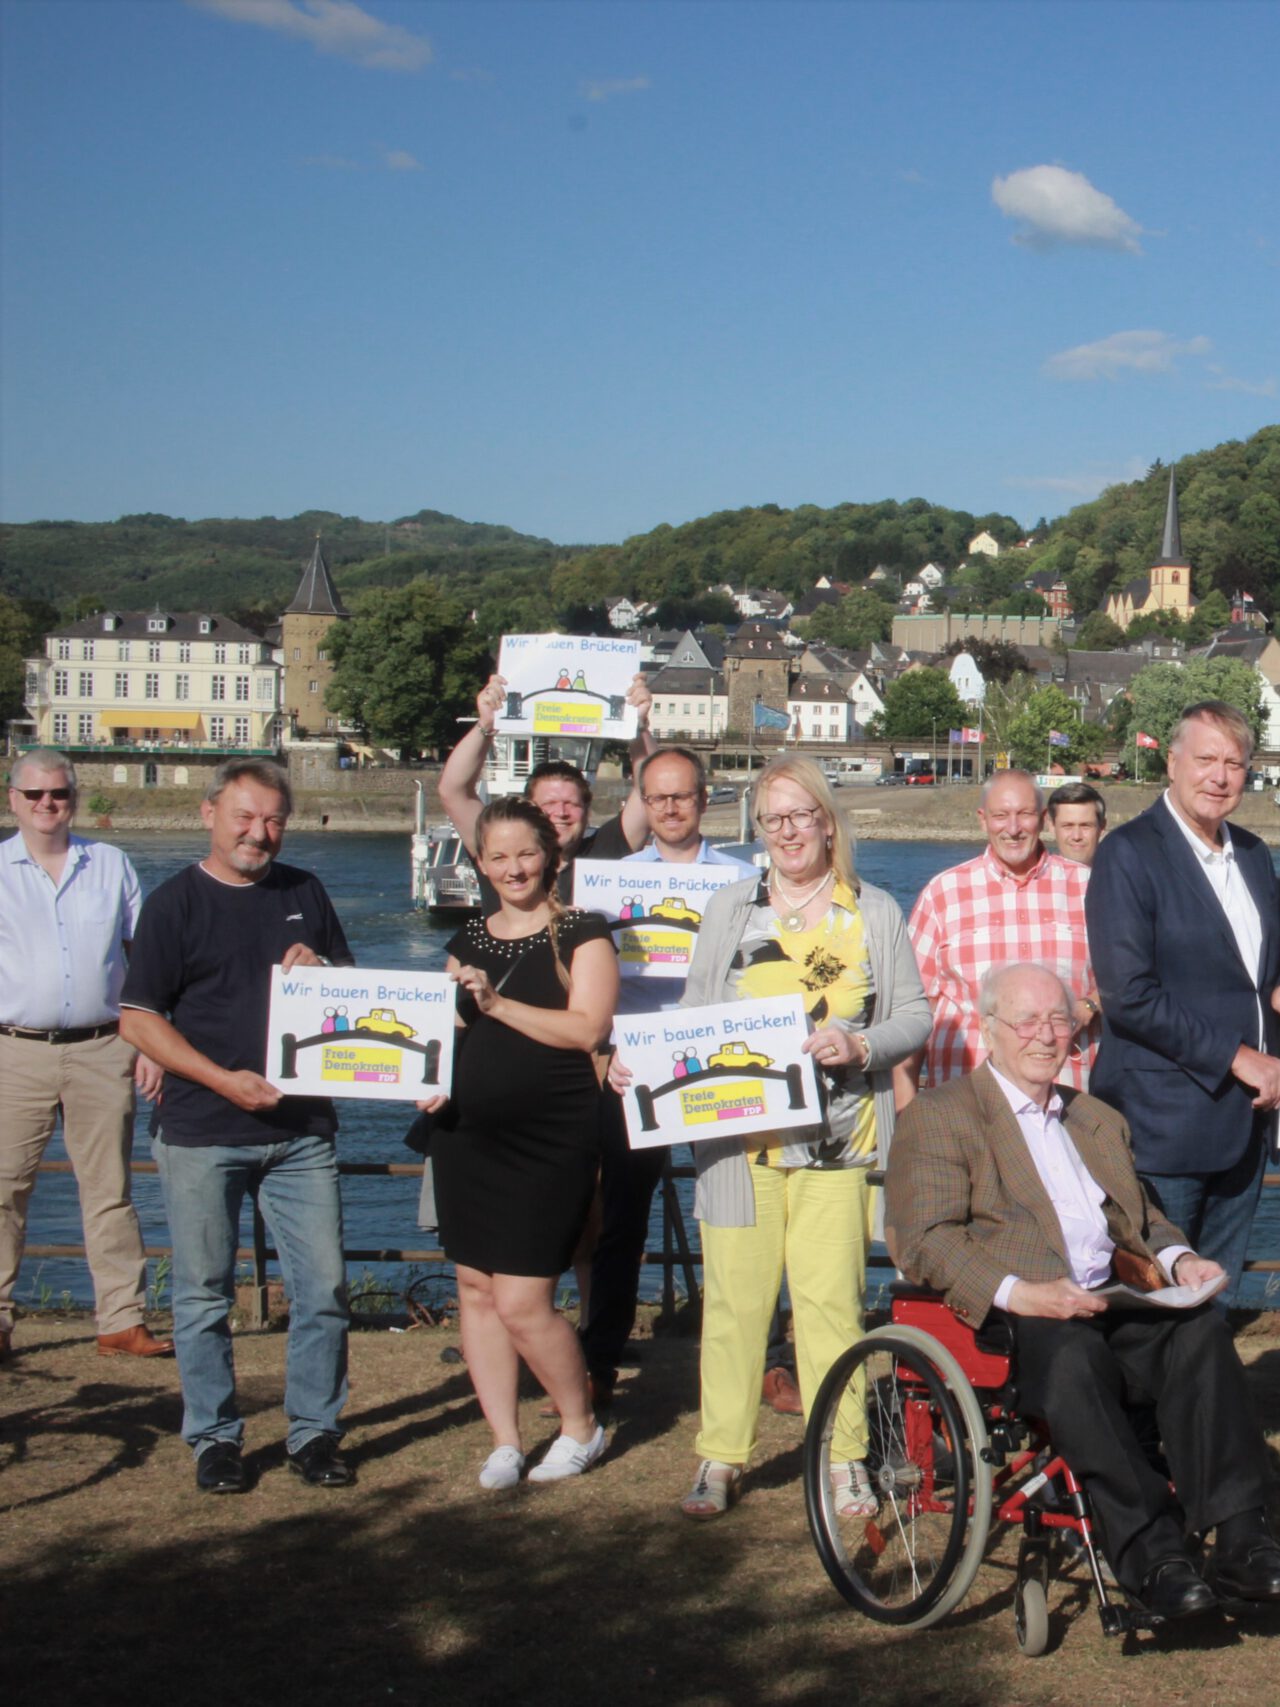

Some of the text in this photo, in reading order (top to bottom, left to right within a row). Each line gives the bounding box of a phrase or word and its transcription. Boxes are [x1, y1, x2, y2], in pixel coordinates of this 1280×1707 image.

[506, 639, 529, 647] Wir
[581, 640, 637, 653] Brücken!
[584, 875, 611, 887] Wir
[619, 876, 661, 889] bauen
[282, 982, 447, 1003] Wir bauen Brücken!
[624, 1011, 796, 1046] Wir bauen Brücken!
[324, 1049, 355, 1059] Freie
[324, 1060, 399, 1072] Demokraten
[683, 1090, 714, 1103] Freie
[684, 1095, 763, 1114] Demokraten
[743, 1106, 761, 1116] FDP
